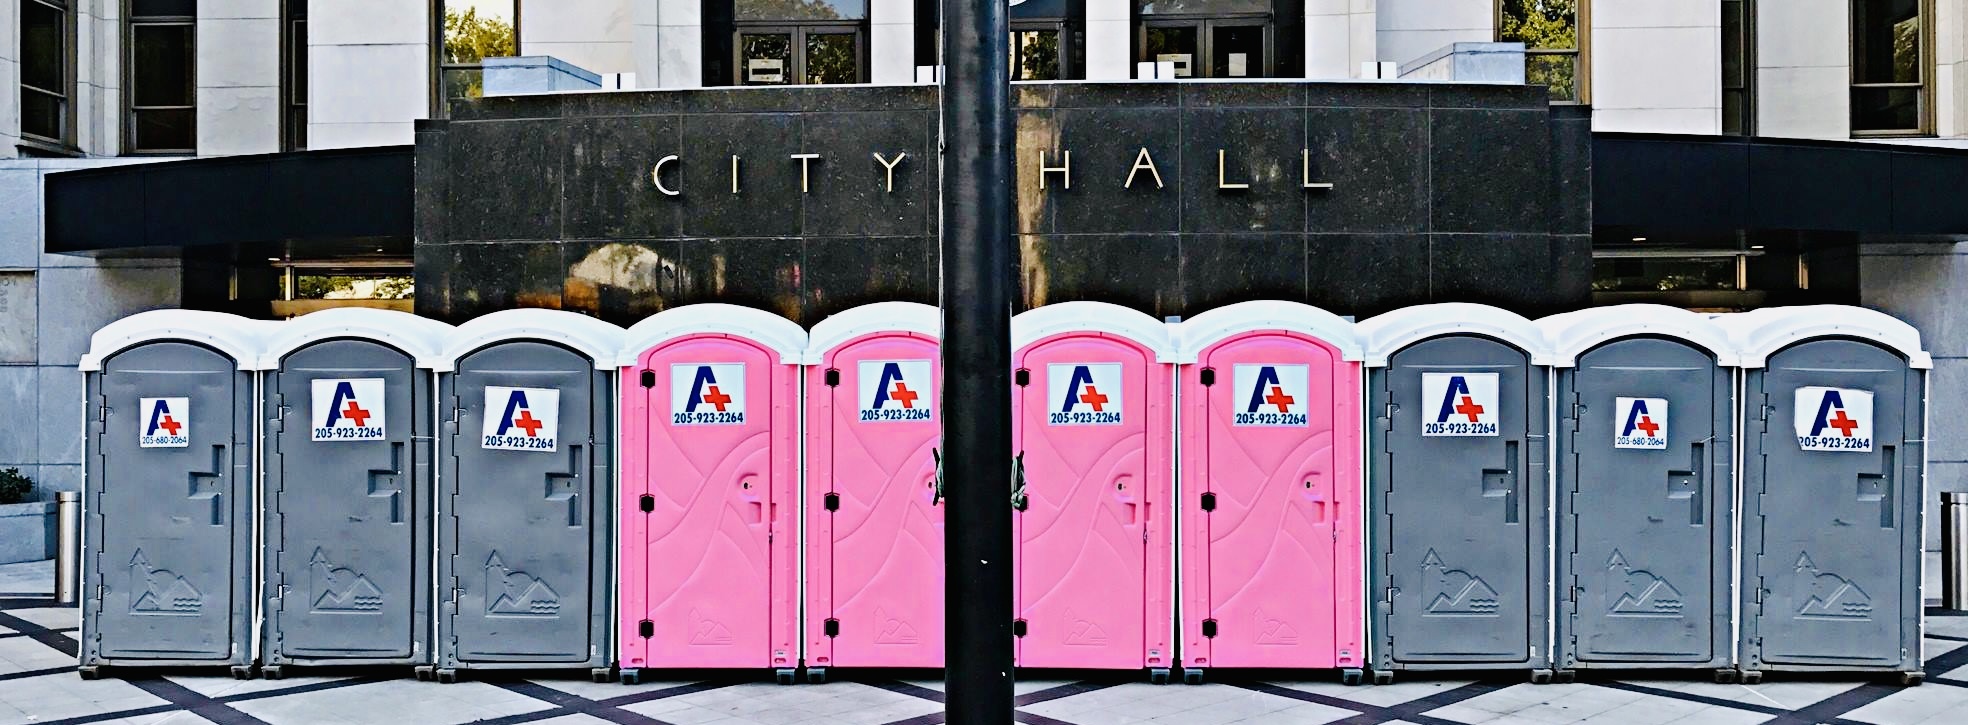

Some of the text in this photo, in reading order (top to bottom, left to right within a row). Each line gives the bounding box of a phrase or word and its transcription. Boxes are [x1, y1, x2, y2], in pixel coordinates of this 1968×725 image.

[653, 147, 1334, 196] CITY HALL
[674, 412, 743, 424] 205-923-2264
[861, 408, 931, 420] 205-923-2264
[1050, 412, 1120, 424] 205-923-2264
[1235, 413, 1306, 424] 205-923-2264
[315, 427, 383, 439] 205-923-2264
[1425, 422, 1496, 434] 205-923-2264
[142, 436, 188, 445] 205-680-2064
[485, 435, 555, 449] 205-923-2264
[1617, 436, 1665, 446] 205-680-2064
